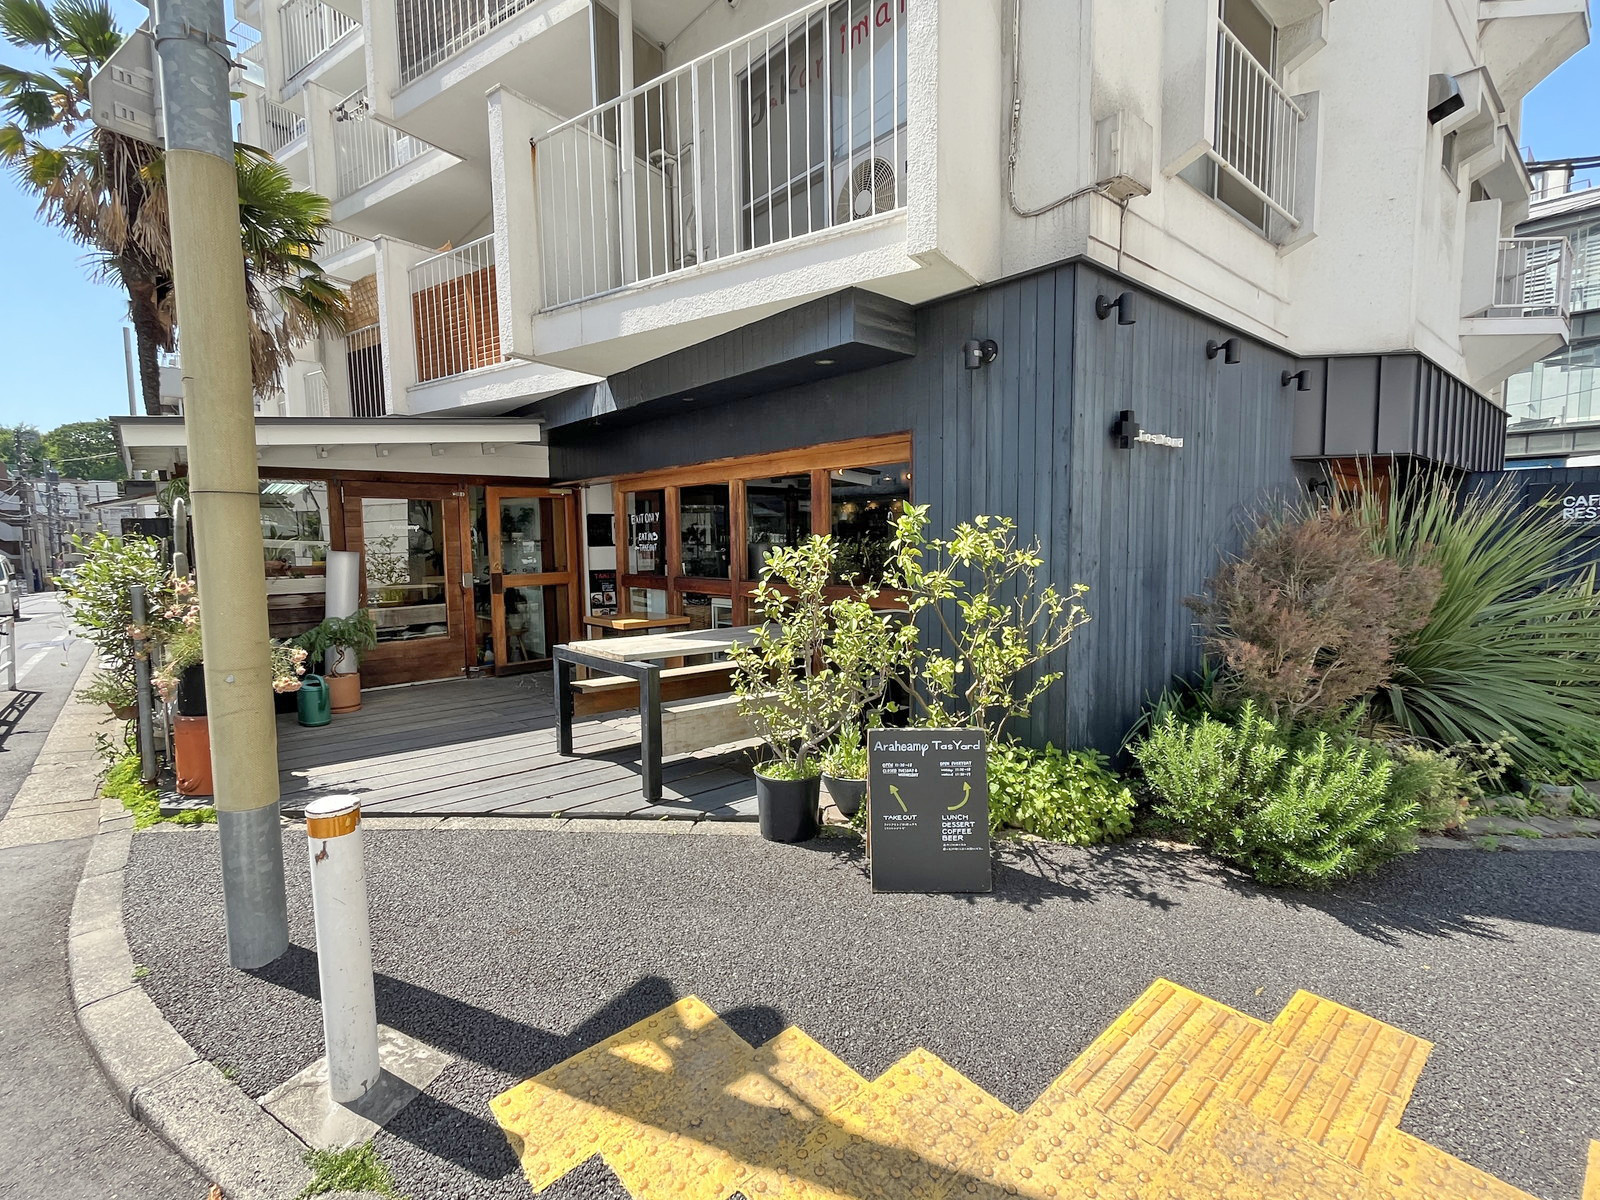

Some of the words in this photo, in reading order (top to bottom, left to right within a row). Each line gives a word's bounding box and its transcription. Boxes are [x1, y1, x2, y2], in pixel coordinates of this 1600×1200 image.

[1563, 495, 1600, 507] CAF
[1563, 507, 1600, 520] RES
[874, 740, 929, 756] Araheamp
